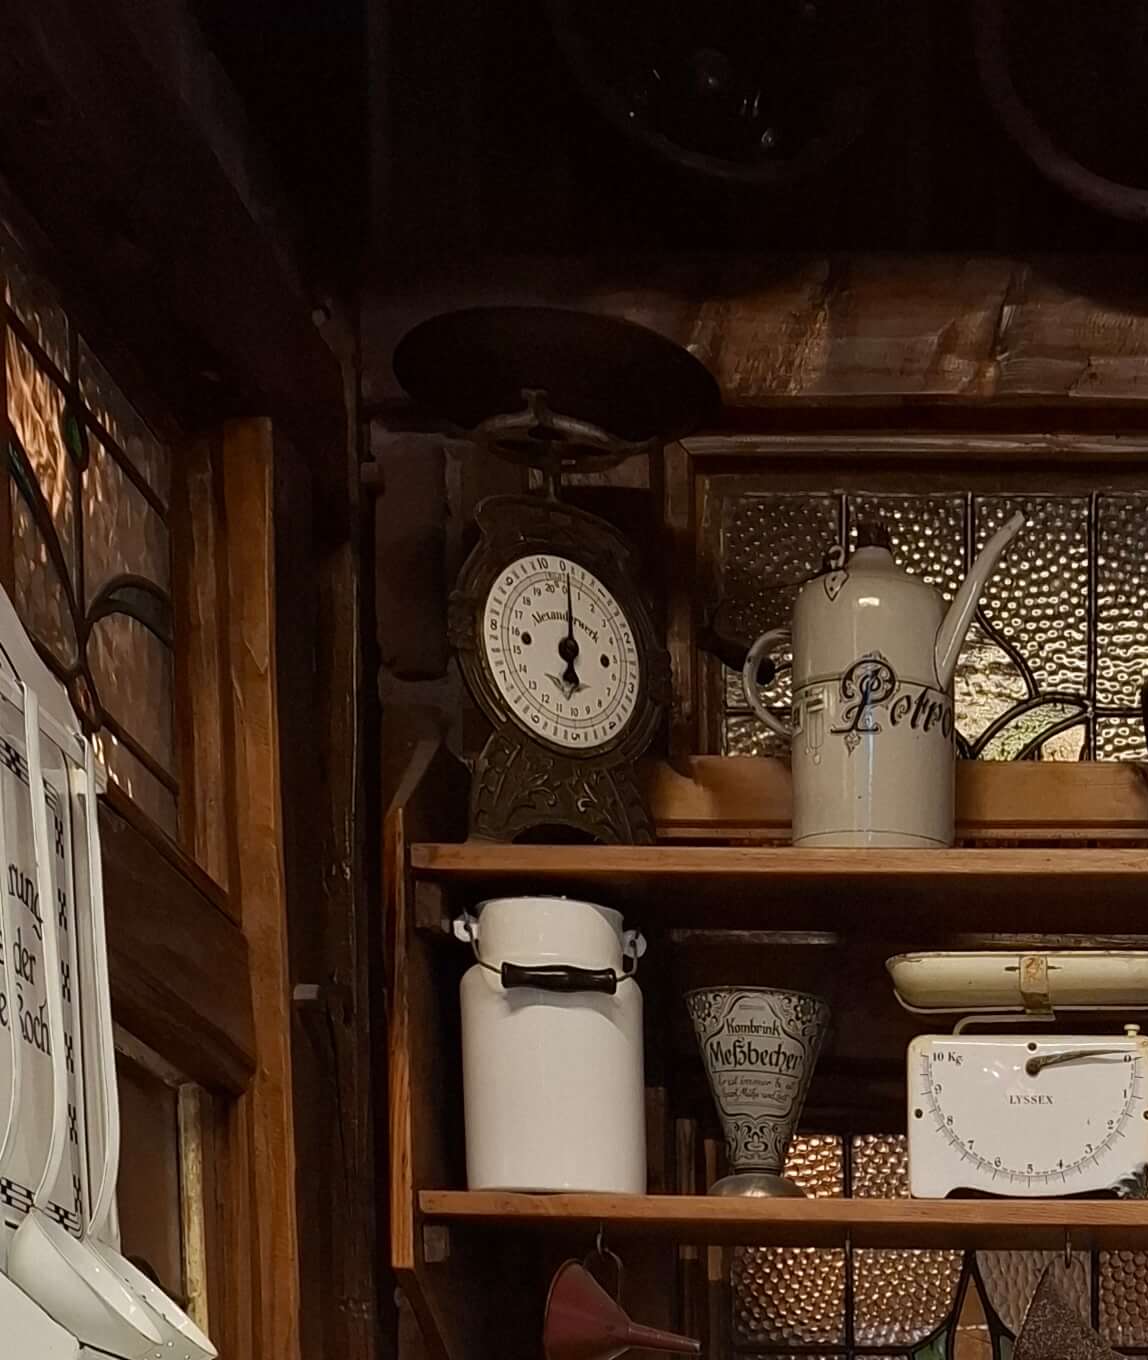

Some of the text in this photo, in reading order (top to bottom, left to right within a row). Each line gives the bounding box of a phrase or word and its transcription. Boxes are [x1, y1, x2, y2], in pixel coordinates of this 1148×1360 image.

[537, 557, 549, 569] 10
[559, 560, 567, 571] 0
[514, 610, 524, 619] 17
[490, 619, 498, 630] 8
[531, 610, 599, 644] Alexandrwerk
[511, 626, 520, 636] 16
[624, 632, 631, 643] 2
[513, 645, 522, 655] 15
[519, 664, 527, 673] 14
[499, 670, 507, 681] 7
[528, 680, 537, 690] 13
[627, 683, 635, 693] 3
[541, 694, 550, 704] 12
[556, 703, 563, 713] 11
[571, 707, 579, 717] 10
[13, 928, 36, 985] der
[933, 1051, 963, 1066] 10 Kg
[934, 1083, 942, 1095] 9
[946, 1114, 953, 1126] 8
[1107, 1119, 1114, 1130] 2
[967, 1139, 974, 1150] 7
[1084, 1143, 1093, 1154] 3
[994, 1156, 1002, 1168] 6
[1056, 1158, 1063, 1169] 4
[1027, 1163, 1033, 1174] 5
